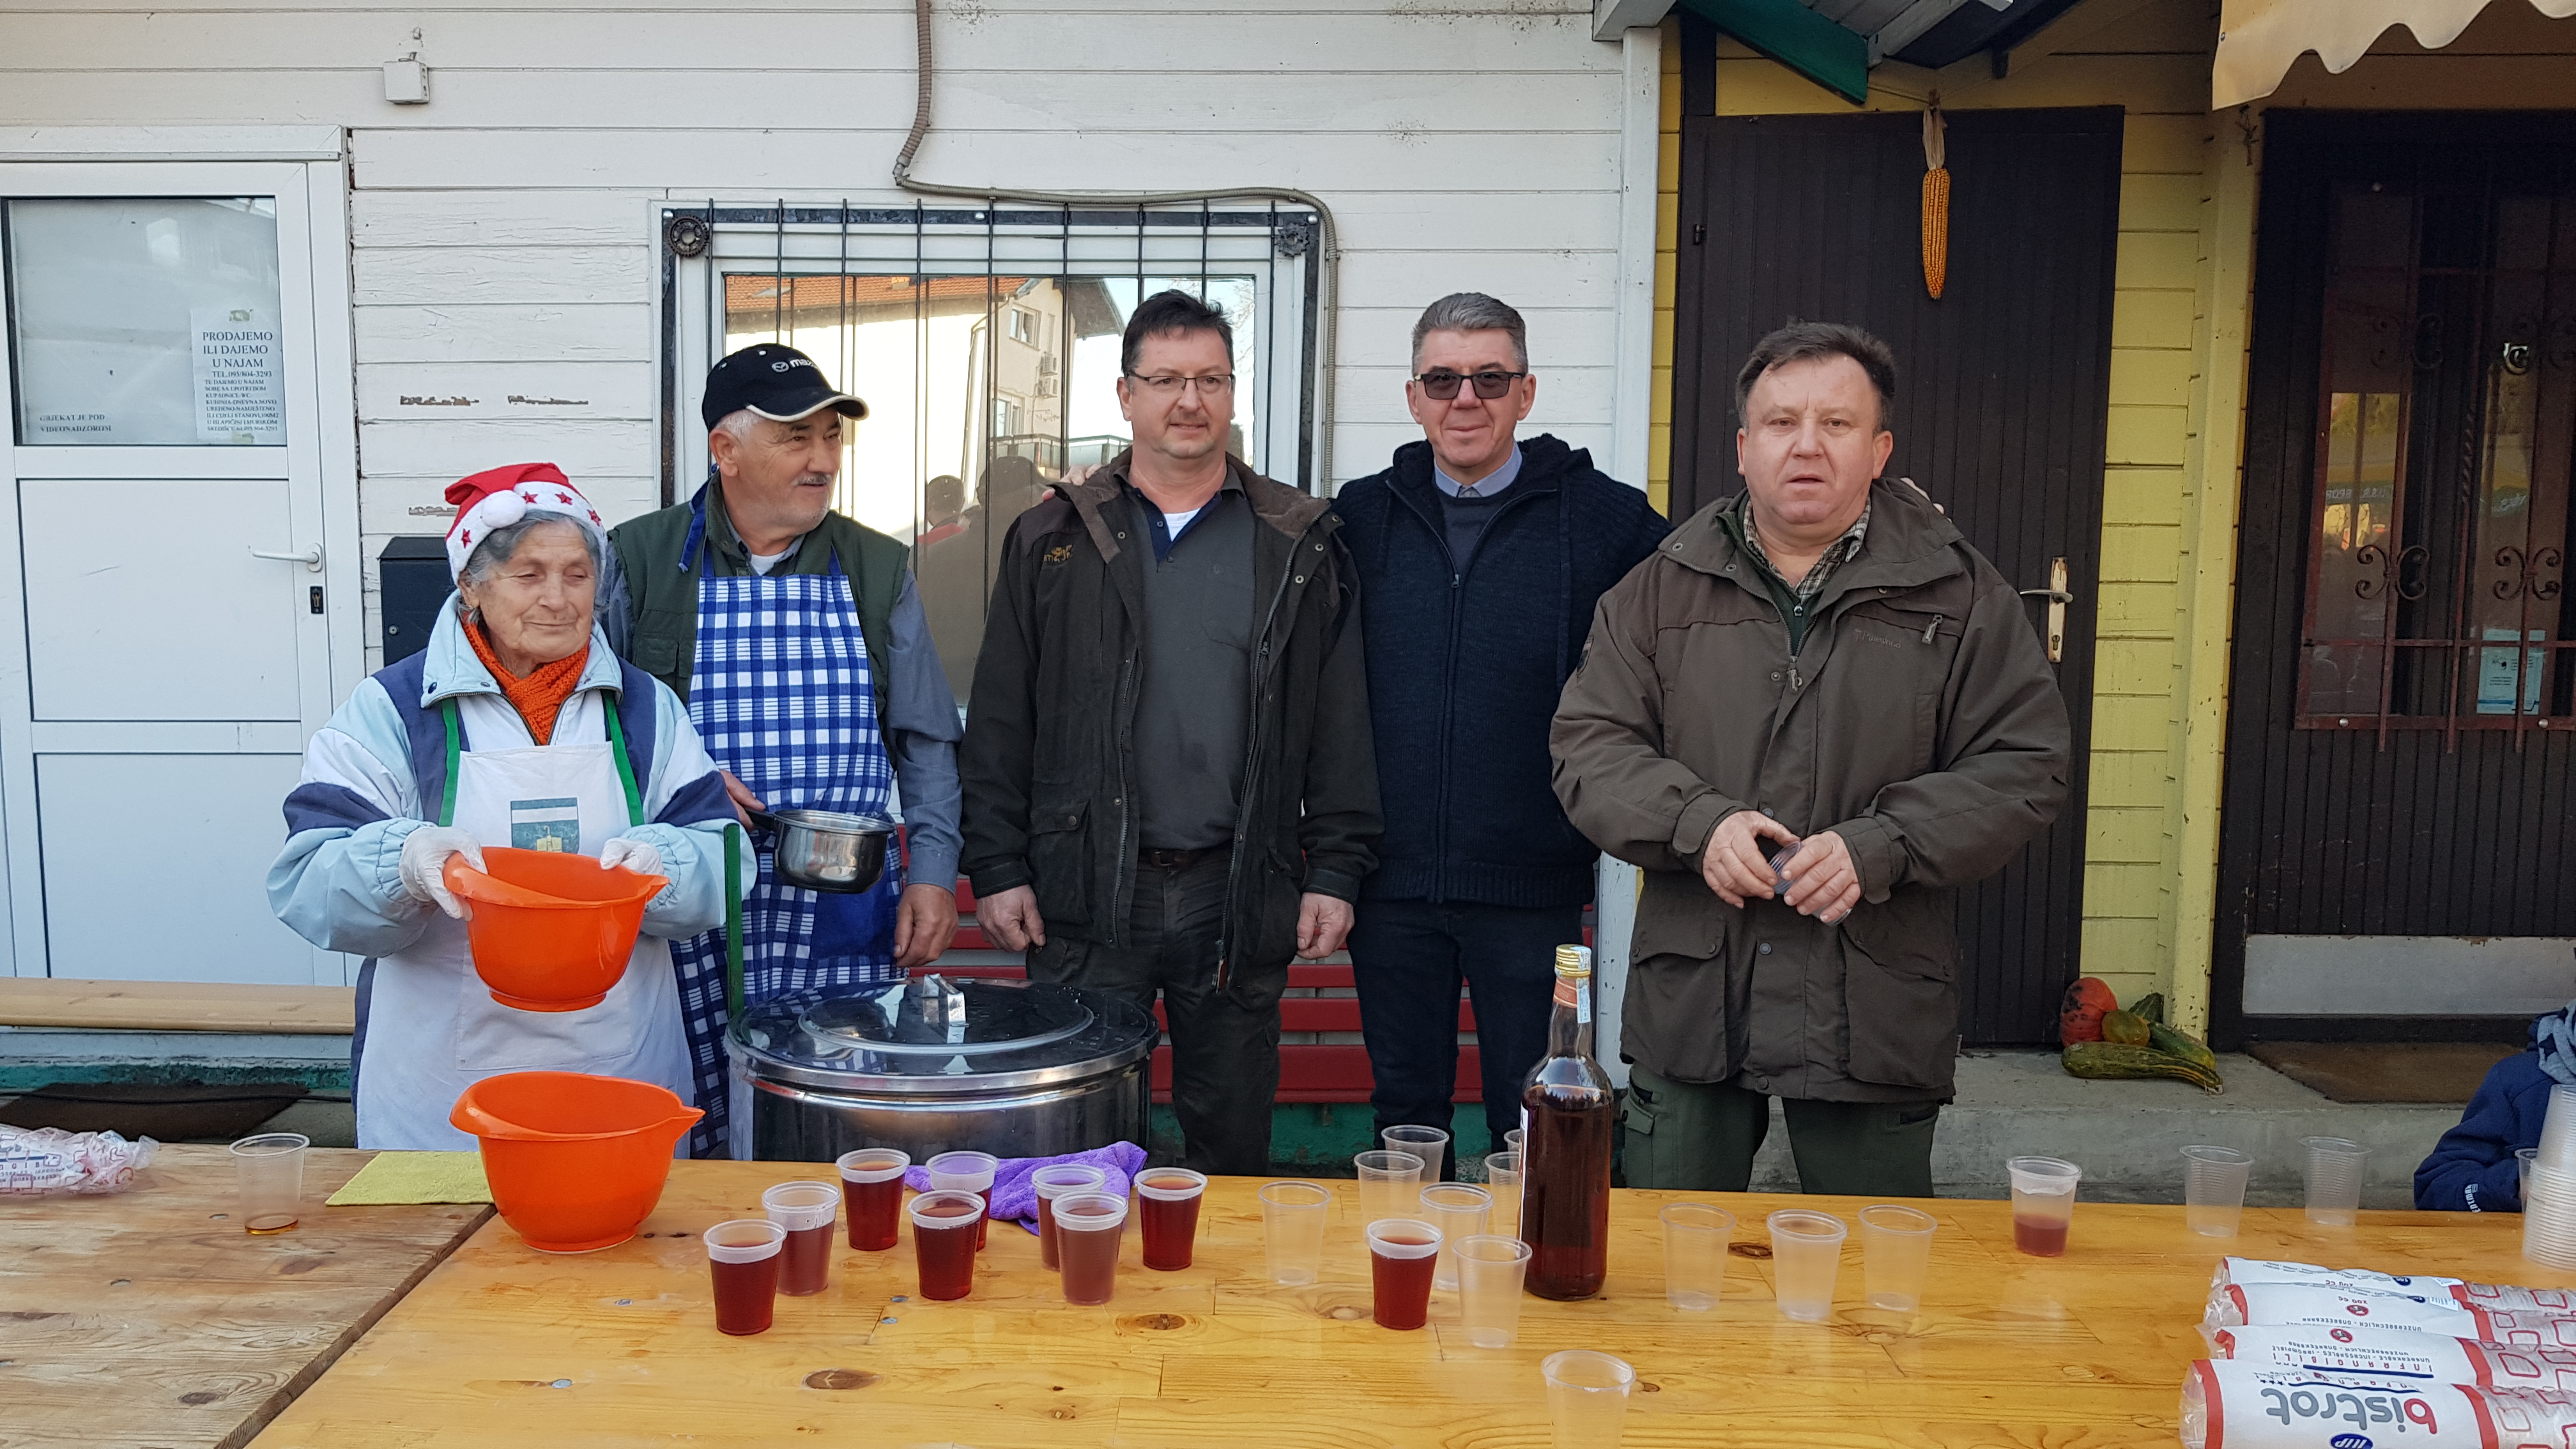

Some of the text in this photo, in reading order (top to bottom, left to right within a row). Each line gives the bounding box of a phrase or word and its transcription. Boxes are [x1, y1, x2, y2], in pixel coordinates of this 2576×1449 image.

[203, 331, 273, 341] PRODAJEMO
[203, 344, 268, 354] ILI DAJEMO
[213, 358, 264, 367] U NAJAM
[2260, 1388, 2437, 1435] bistrot
